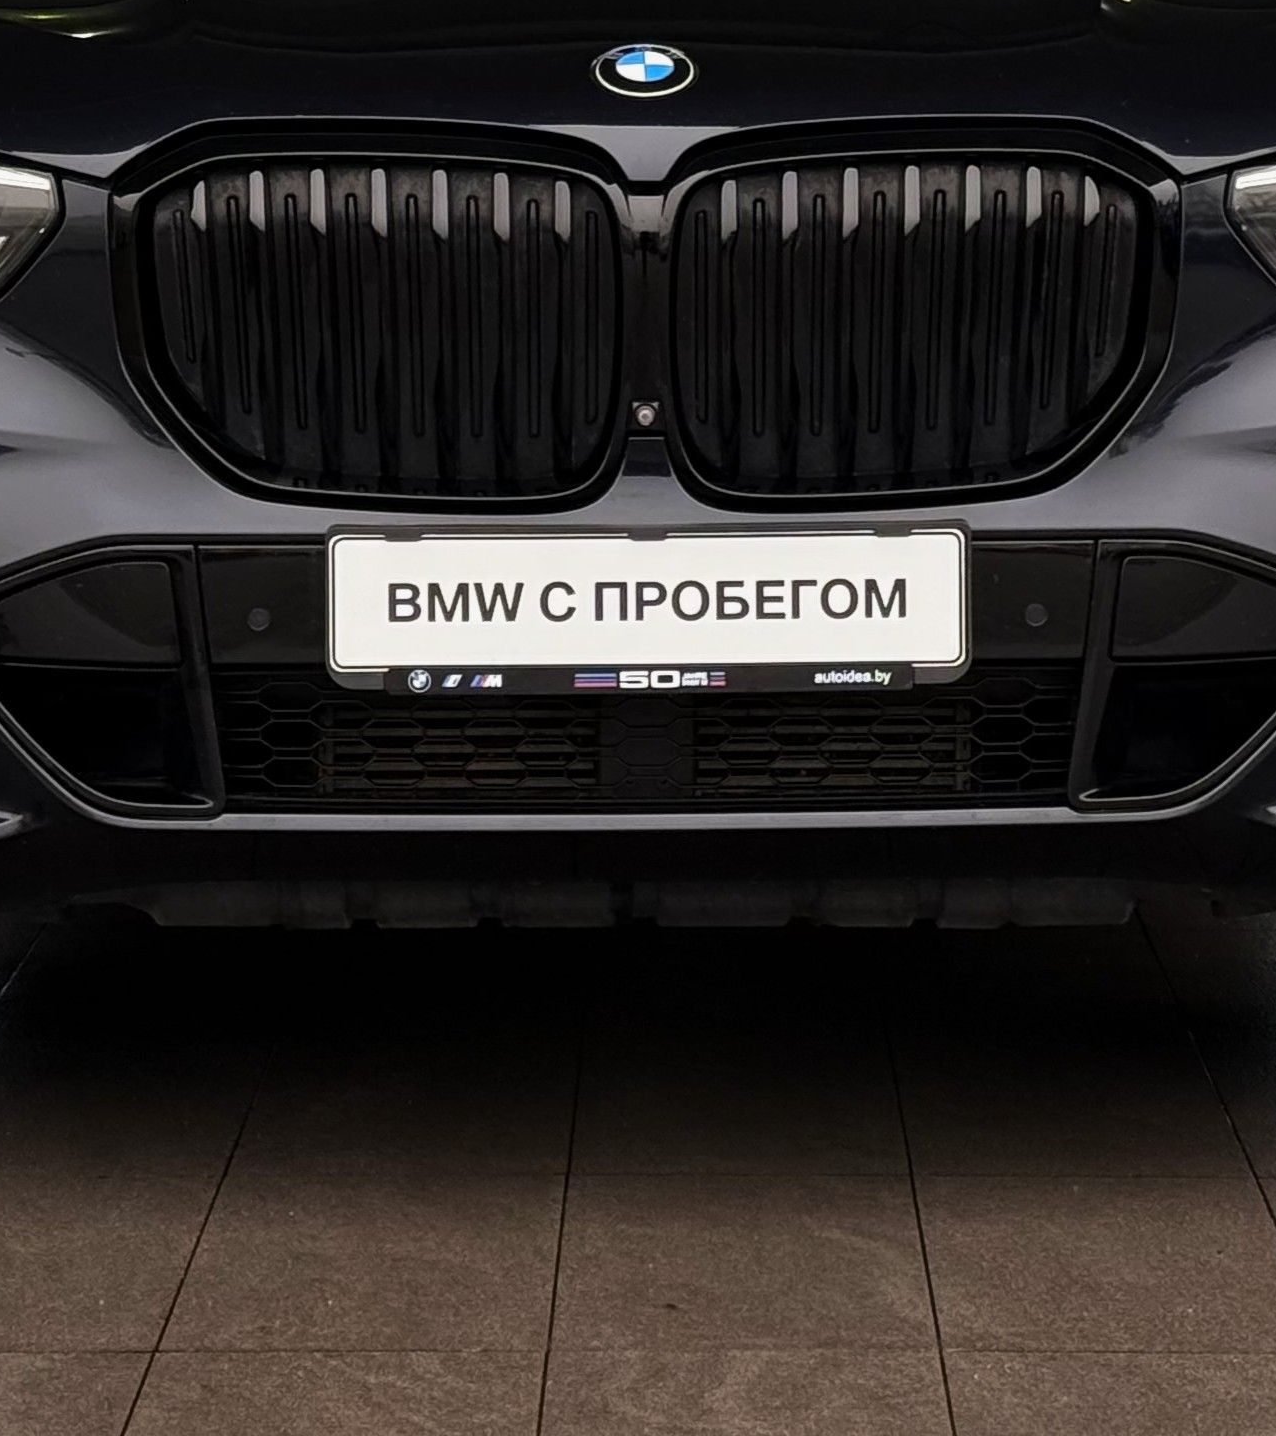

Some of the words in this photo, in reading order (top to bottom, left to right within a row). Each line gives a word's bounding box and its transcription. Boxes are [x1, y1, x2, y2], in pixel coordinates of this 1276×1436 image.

[388, 582, 523, 622] BMW
[540, 581, 576, 622] С
[594, 578, 908, 621] ПРОБЕГОМ
[618, 670, 681, 689] 50
[812, 667, 892, 688] autoidea.by
